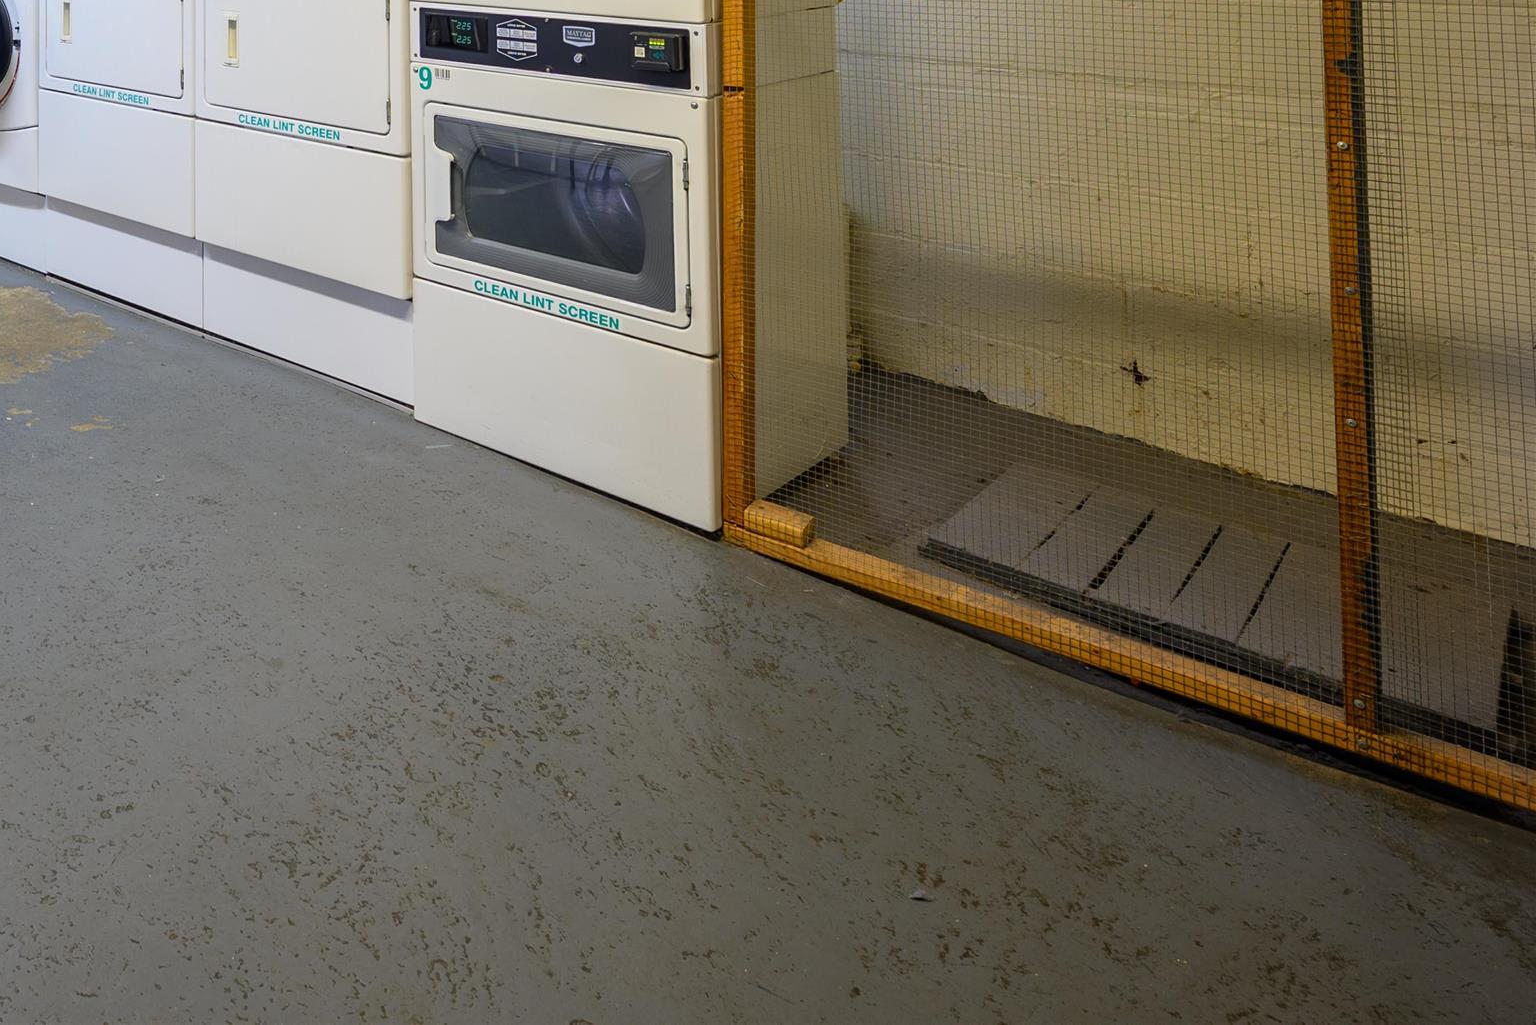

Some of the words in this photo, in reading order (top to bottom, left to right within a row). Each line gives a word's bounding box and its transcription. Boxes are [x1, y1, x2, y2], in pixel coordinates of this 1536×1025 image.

[567, 30, 591, 38] MAYTAG
[419, 66, 433, 90] 9
[73, 83, 97, 96] CLEAN
[99, 88, 115, 99] LINT
[117, 92, 149, 105] SCREEN
[238, 114, 270, 127] CLEAN
[273, 120, 295, 132] LINT
[297, 124, 340, 140] SCREEN
[474, 280, 518, 301] CLEAN
[523, 292, 554, 311] LINT
[558, 303, 619, 330] SCREEN
